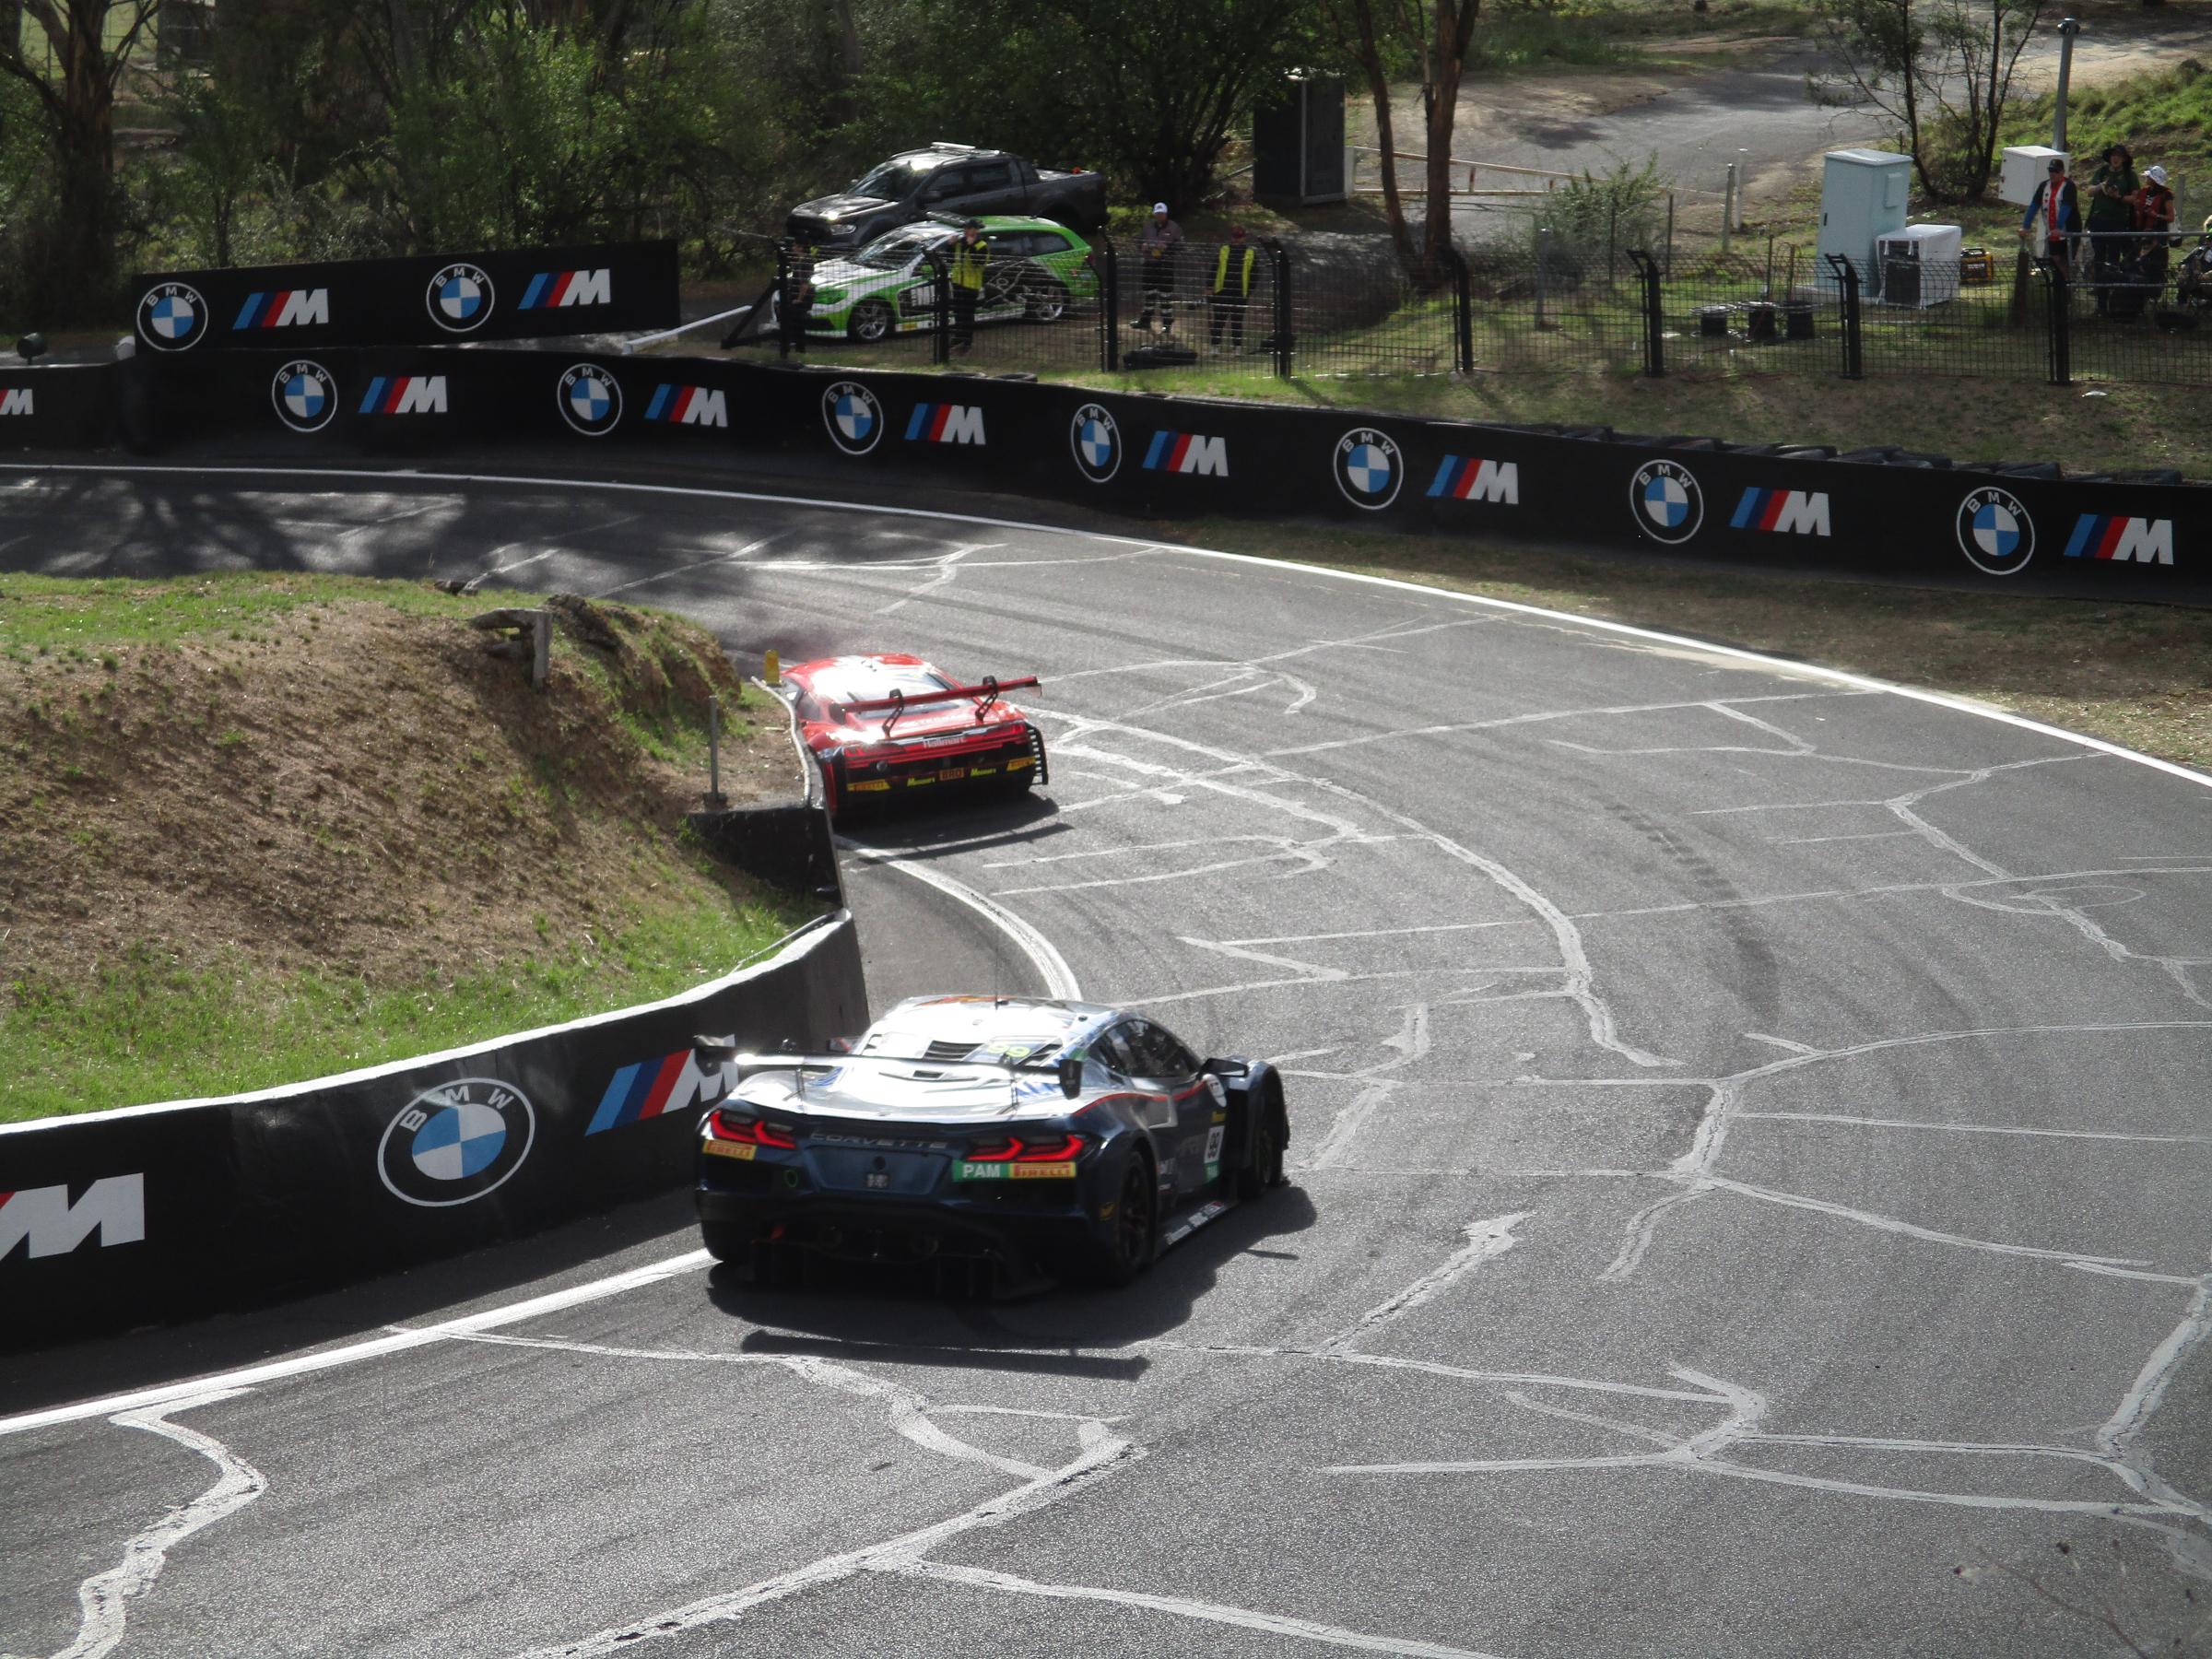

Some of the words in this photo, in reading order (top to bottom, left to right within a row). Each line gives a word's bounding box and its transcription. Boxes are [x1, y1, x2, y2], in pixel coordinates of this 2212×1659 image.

[400, 1084, 515, 1132] BMW
[809, 1133, 949, 1149] CORVETTE
[962, 1163, 1001, 1179] PAM
[0, 1172, 145, 1261] M
